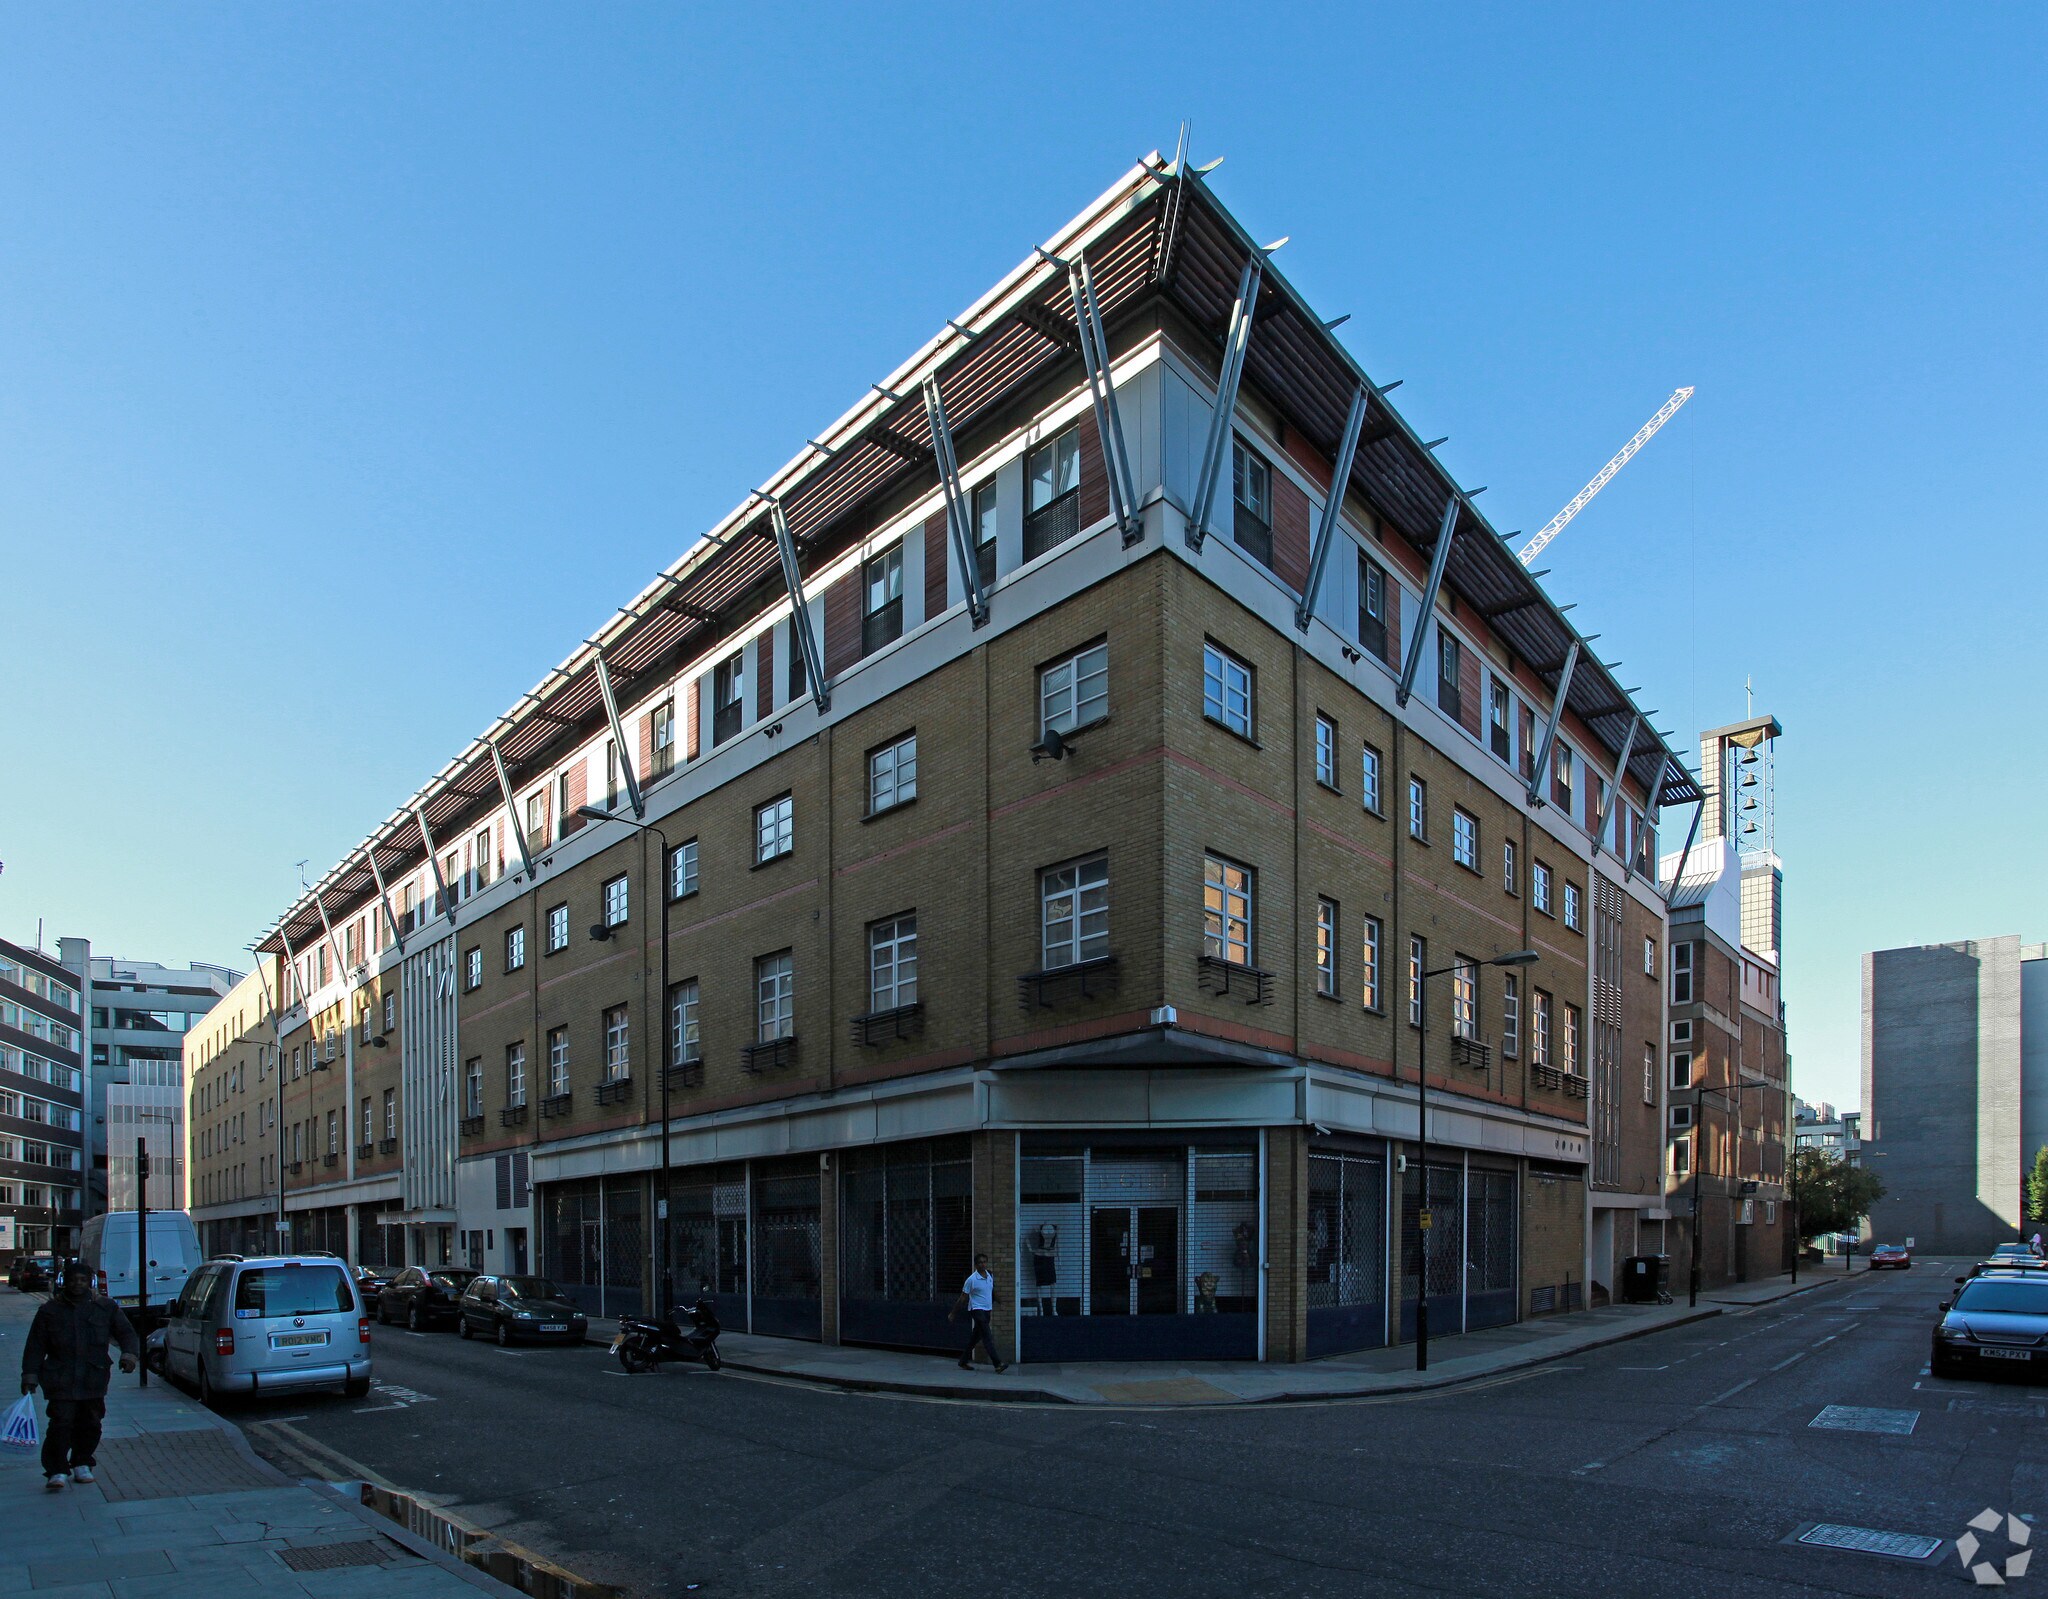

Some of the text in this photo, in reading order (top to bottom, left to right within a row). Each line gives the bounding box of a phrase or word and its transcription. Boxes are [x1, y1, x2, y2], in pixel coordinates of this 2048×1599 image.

[1984, 1349, 2027, 1358] KM52 PXV
[6, 1435, 37, 1446] TESCO
